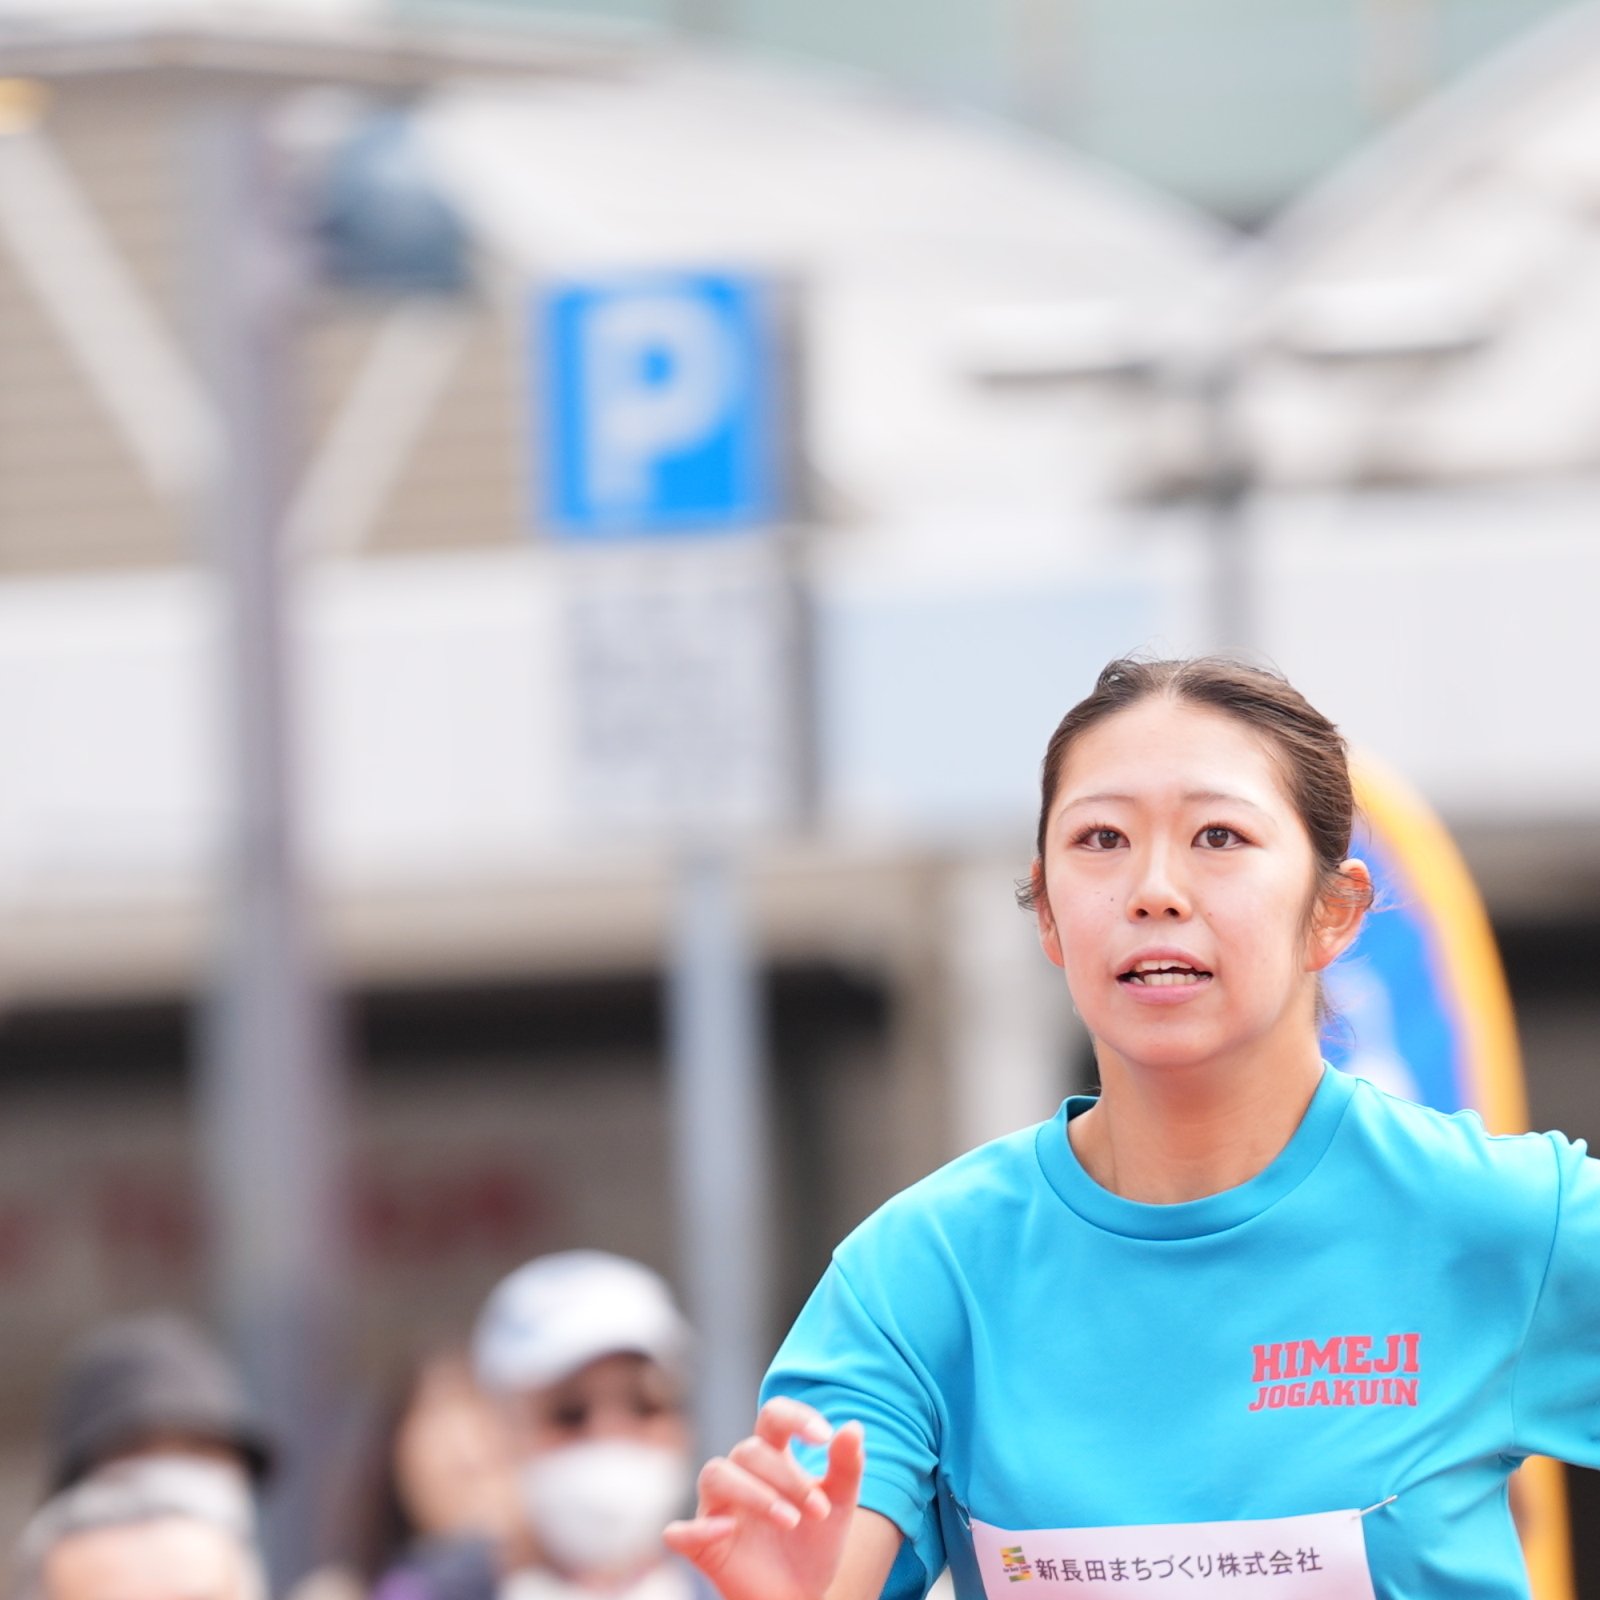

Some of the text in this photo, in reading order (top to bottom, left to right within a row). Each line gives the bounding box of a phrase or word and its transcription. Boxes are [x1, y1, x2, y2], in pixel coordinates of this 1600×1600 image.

[580, 290, 745, 508] P
[1252, 1333, 1420, 1382] HIMEJI
[1248, 1378, 1418, 1411] JOGAKUIN
[1035, 1547, 1323, 1582] 新長田まちづくり株式会社
